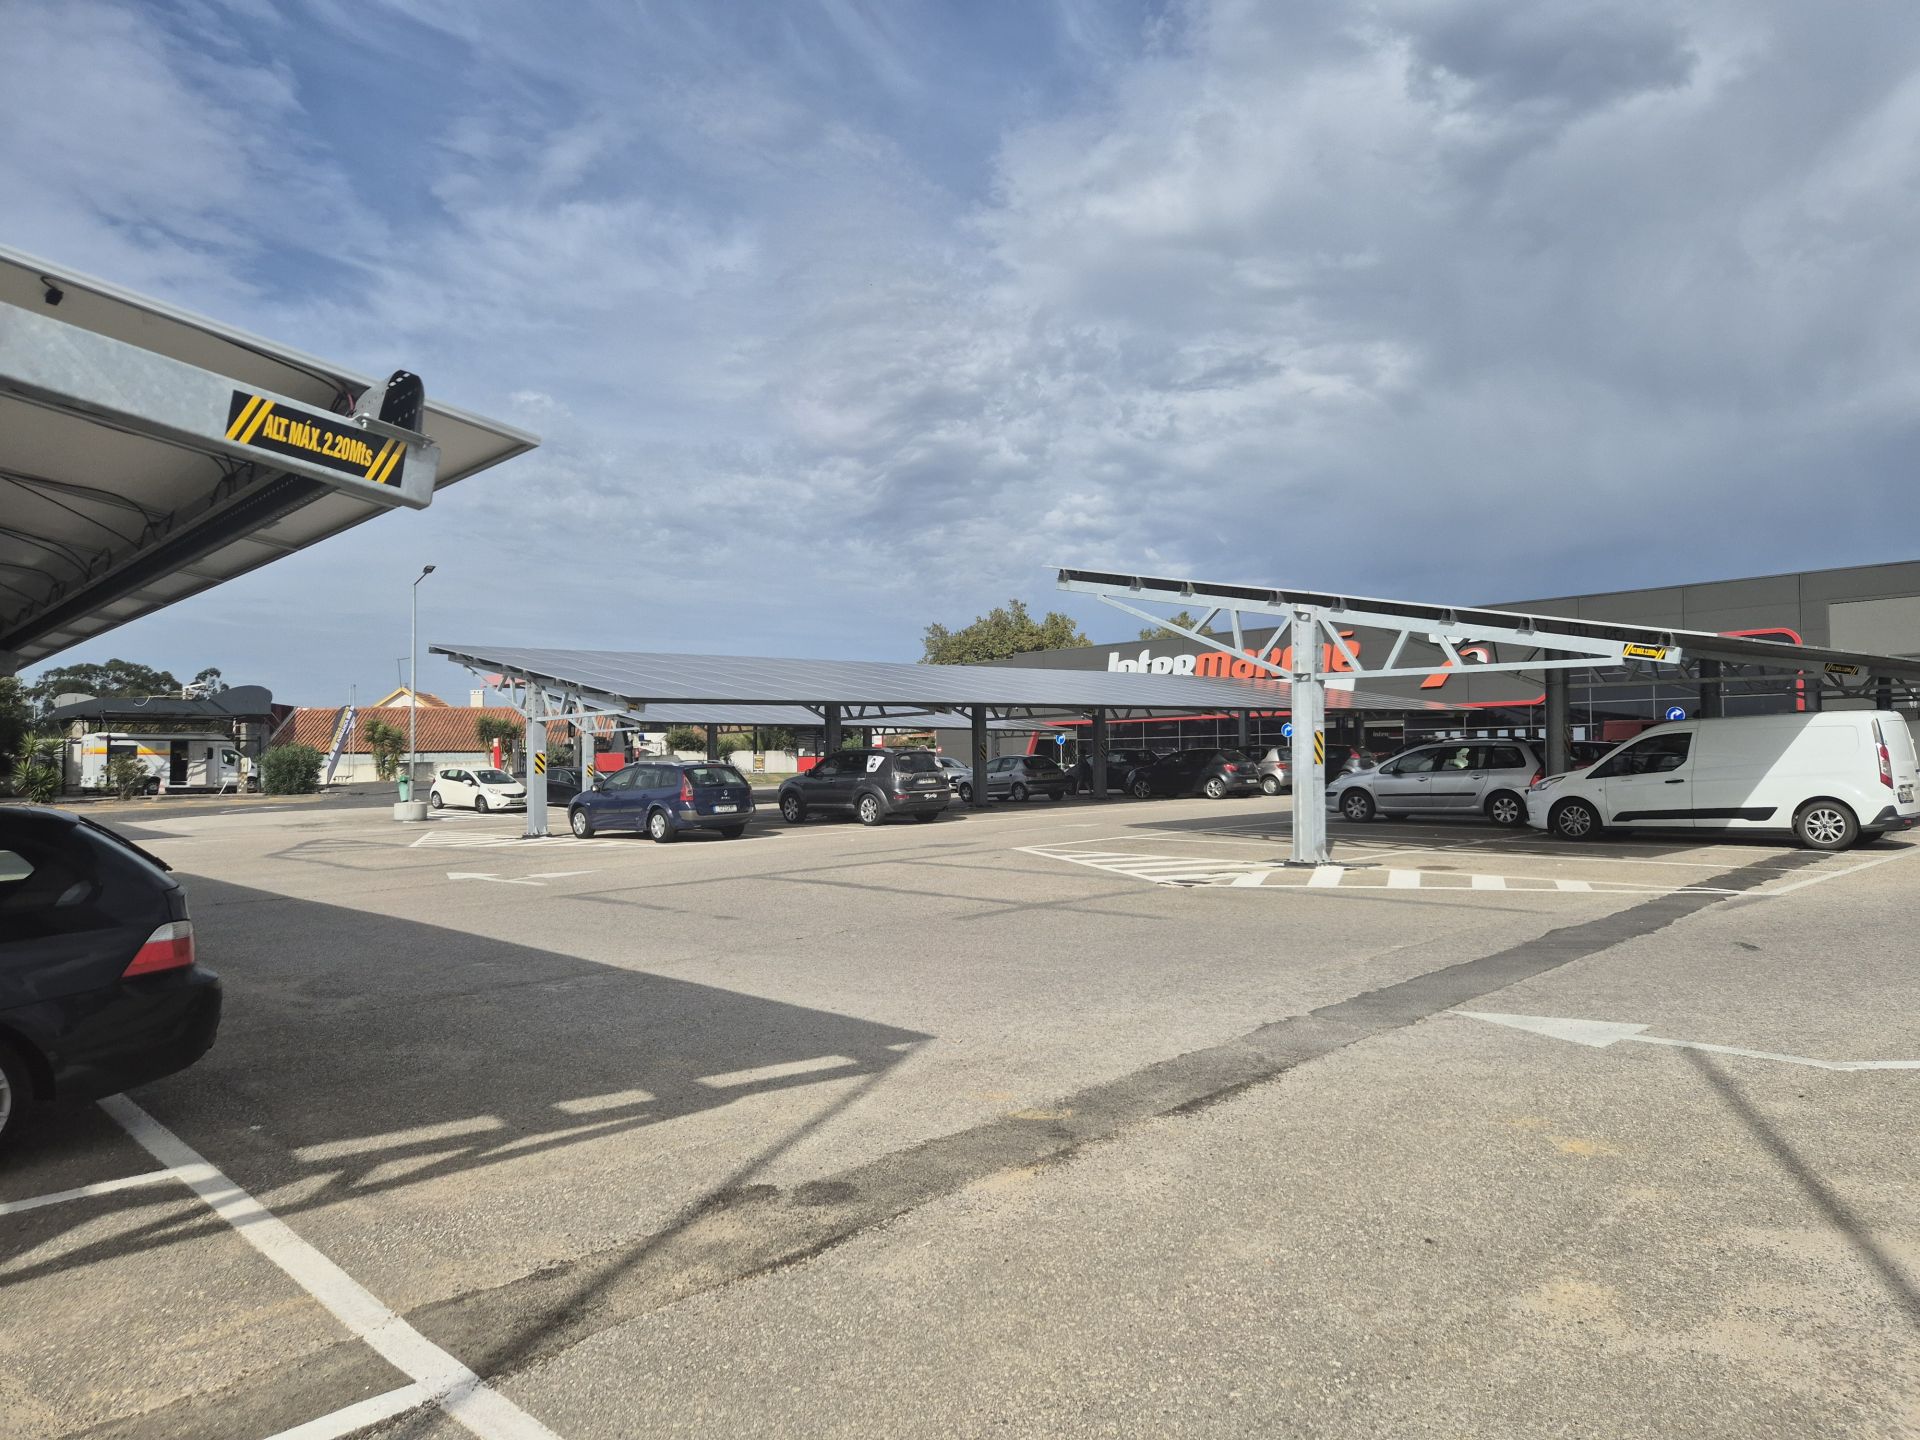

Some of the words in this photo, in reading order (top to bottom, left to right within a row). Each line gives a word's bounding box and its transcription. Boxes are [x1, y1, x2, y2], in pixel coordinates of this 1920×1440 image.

[262, 414, 290, 442] ALT.
[288, 420, 321, 452] MÁX.
[322, 432, 373, 467] 2.20Mts
[1107, 630, 1361, 679] Intermaré
